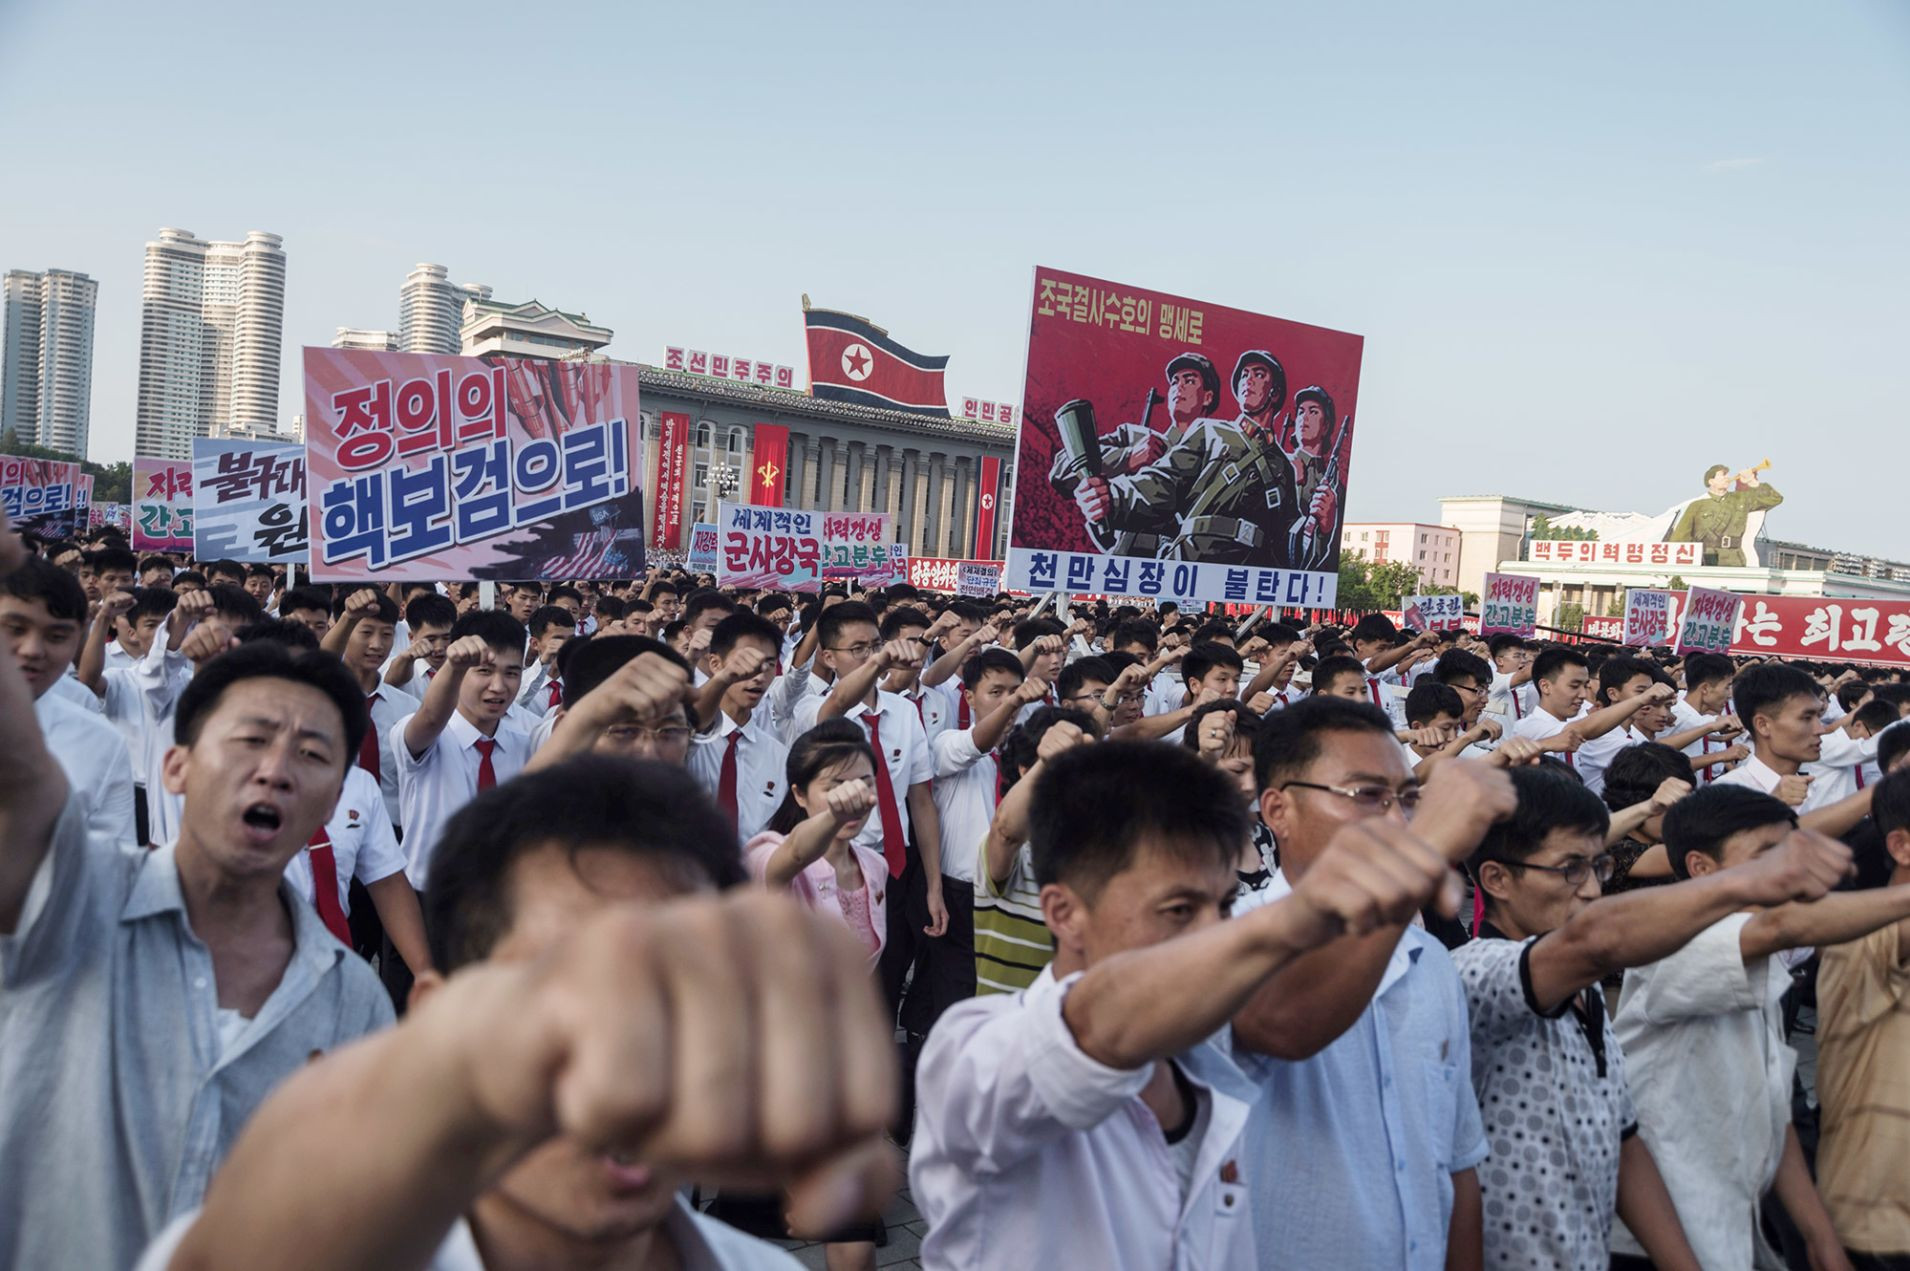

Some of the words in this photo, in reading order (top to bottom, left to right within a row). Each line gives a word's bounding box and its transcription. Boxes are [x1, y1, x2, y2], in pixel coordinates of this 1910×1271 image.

[1038, 279, 1152, 335] 조국결사수호의
[1159, 304, 1204, 345] 맹세로
[666, 348, 793, 388] 조선민주주의
[332, 368, 508, 469] 정의의
[321, 419, 628, 567] 핵보검으로!
[592, 510, 609, 521] USA
[732, 508, 811, 534] 세계적인
[724, 532, 820, 578] 군사강국
[1029, 552, 1198, 598] 천만심장이
[1224, 568, 1325, 604] 불탄다!
[1490, 578, 1536, 604] 자력갱생
[1633, 592, 1665, 609] 세계적인
[1691, 593, 1737, 623] 자력갱생
[1485, 605, 1535, 629] 간고분투
[1629, 608, 1668, 637] 군사강국
[1683, 622, 1732, 650] 간고분투
